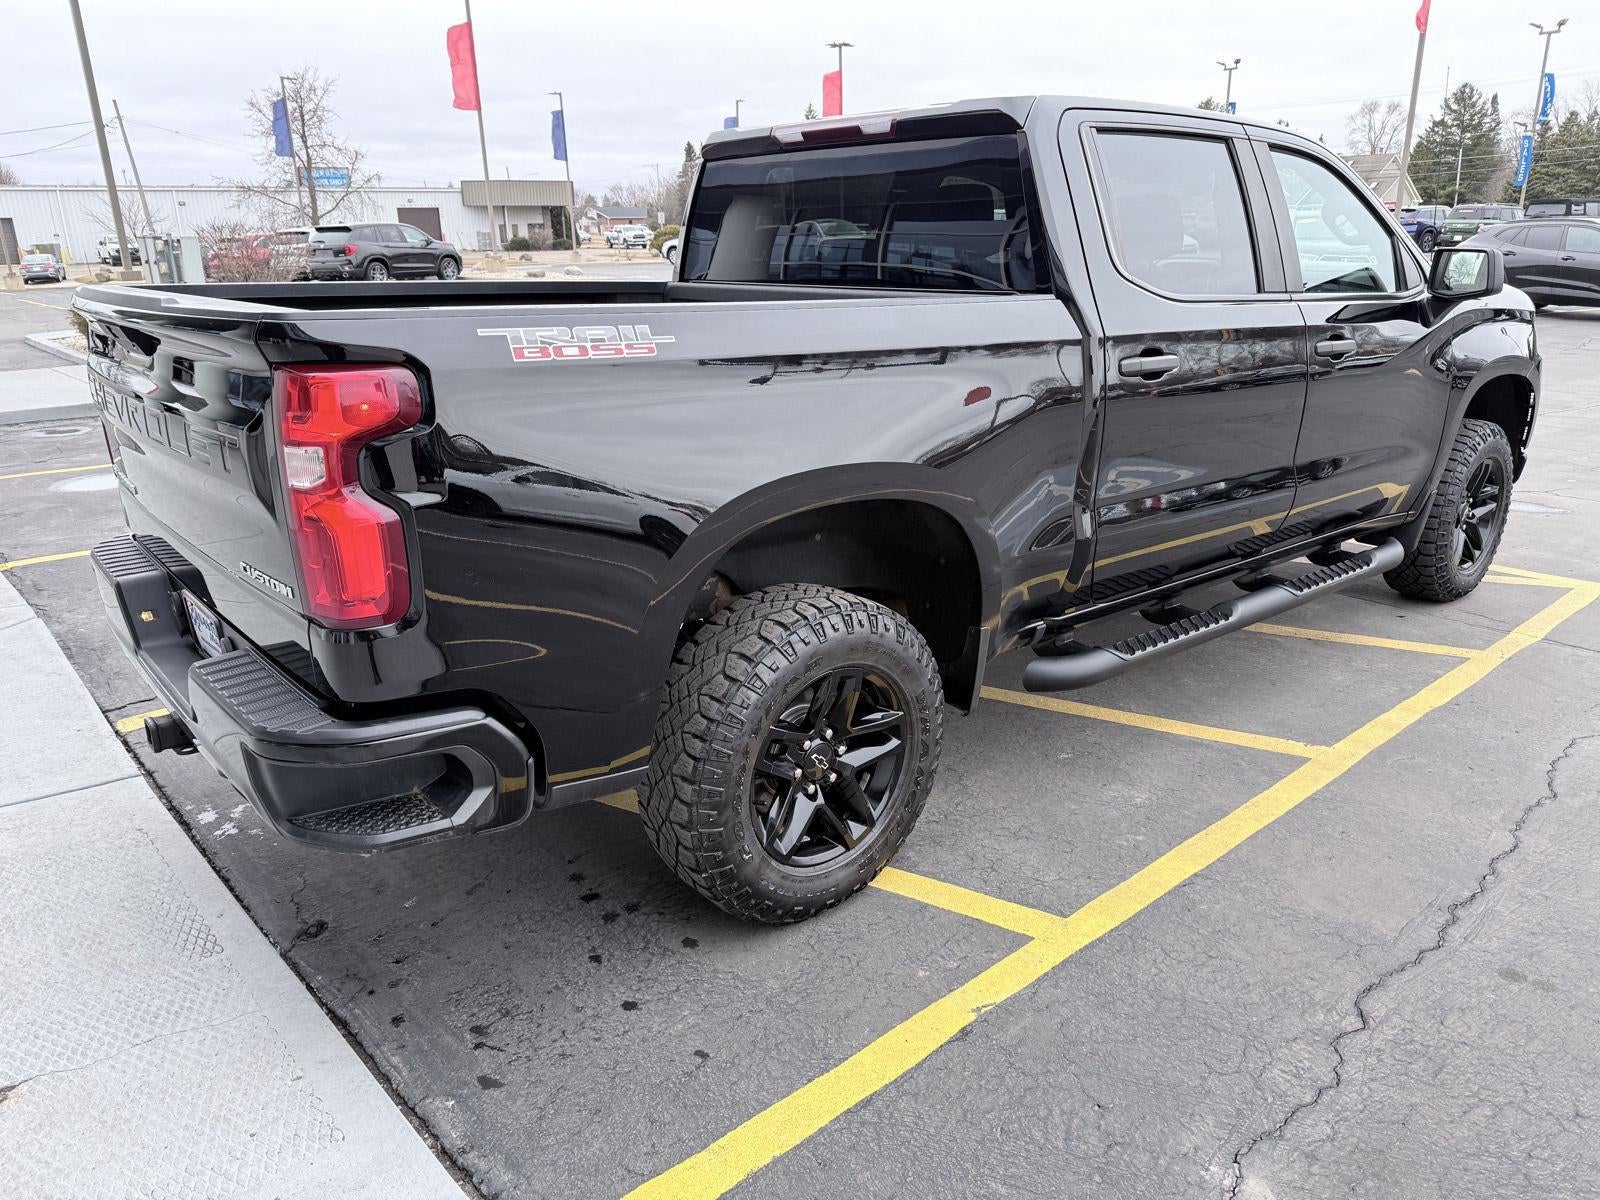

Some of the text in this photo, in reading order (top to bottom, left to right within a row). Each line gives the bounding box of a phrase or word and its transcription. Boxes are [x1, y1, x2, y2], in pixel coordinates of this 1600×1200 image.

[1517, 139, 1529, 182] SALES
[477, 325, 676, 345] TRAIL
[510, 342, 657, 361] BOSS
[88, 372, 240, 474] CHEVROLET
[240, 561, 294, 599] CUSTOM
